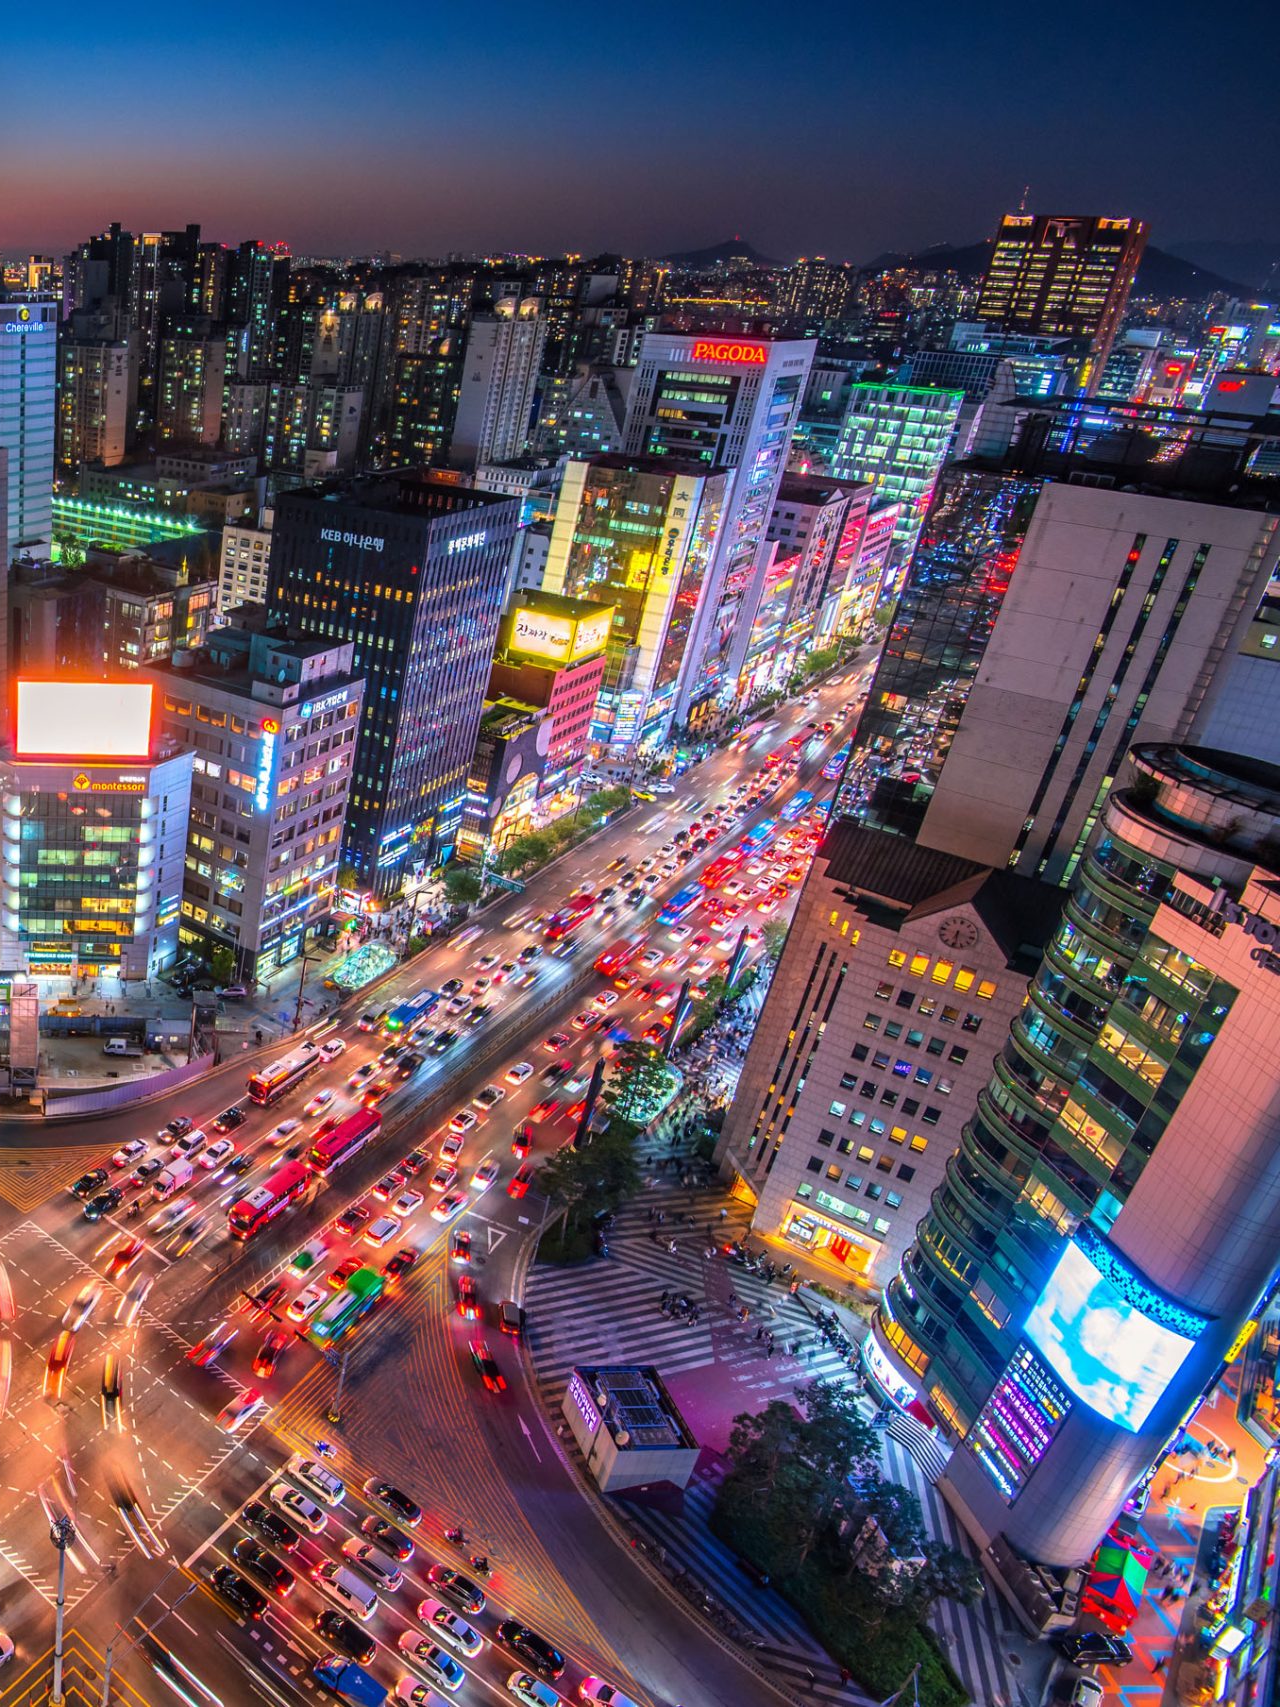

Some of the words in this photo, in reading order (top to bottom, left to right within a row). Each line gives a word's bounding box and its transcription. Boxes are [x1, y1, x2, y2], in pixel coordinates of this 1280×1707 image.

[5, 322, 43, 332] Chereville
[695, 343, 765, 362] PAGODA
[321, 528, 341, 542] KEB
[343, 532, 384, 552] 하나은행
[92, 782, 145, 791] montessori
[570, 1382, 595, 1432] SQUARE
